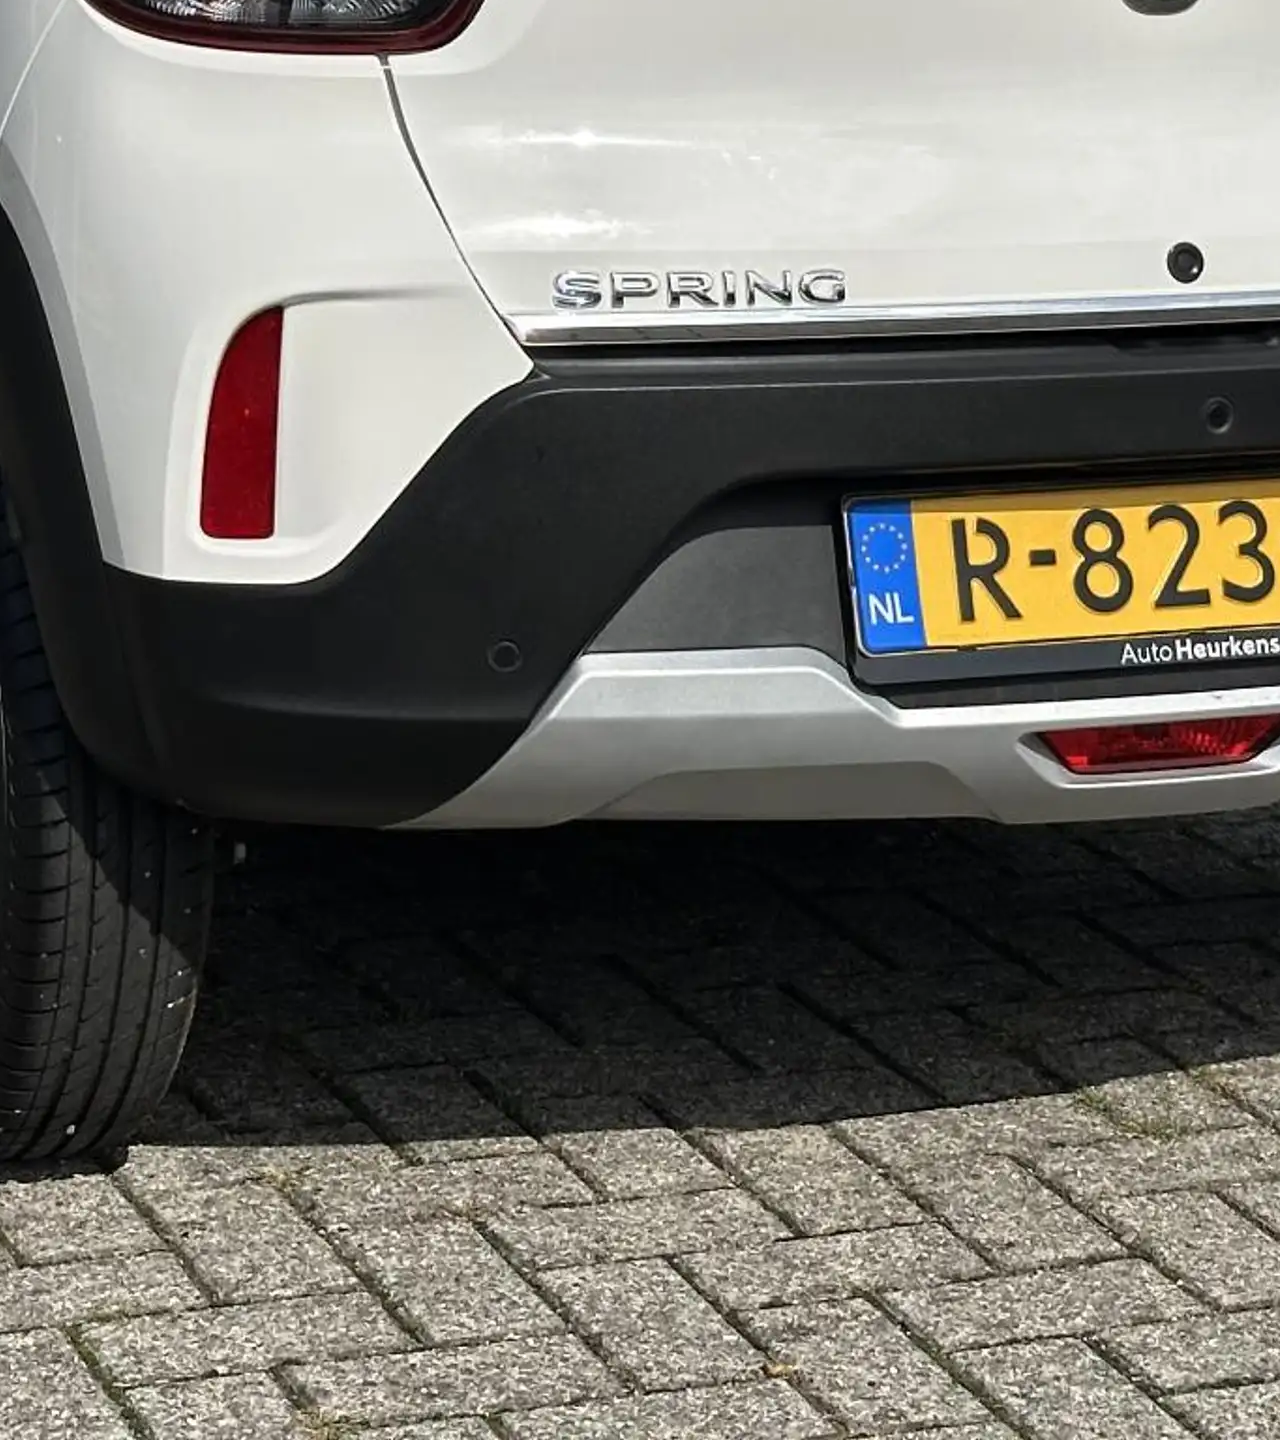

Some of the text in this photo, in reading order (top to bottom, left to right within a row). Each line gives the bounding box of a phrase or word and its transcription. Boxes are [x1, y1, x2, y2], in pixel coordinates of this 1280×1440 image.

[552, 269, 846, 310] SPRING
[868, 591, 914, 626] NL
[1175, 635, 1280, 661] Heurkens
